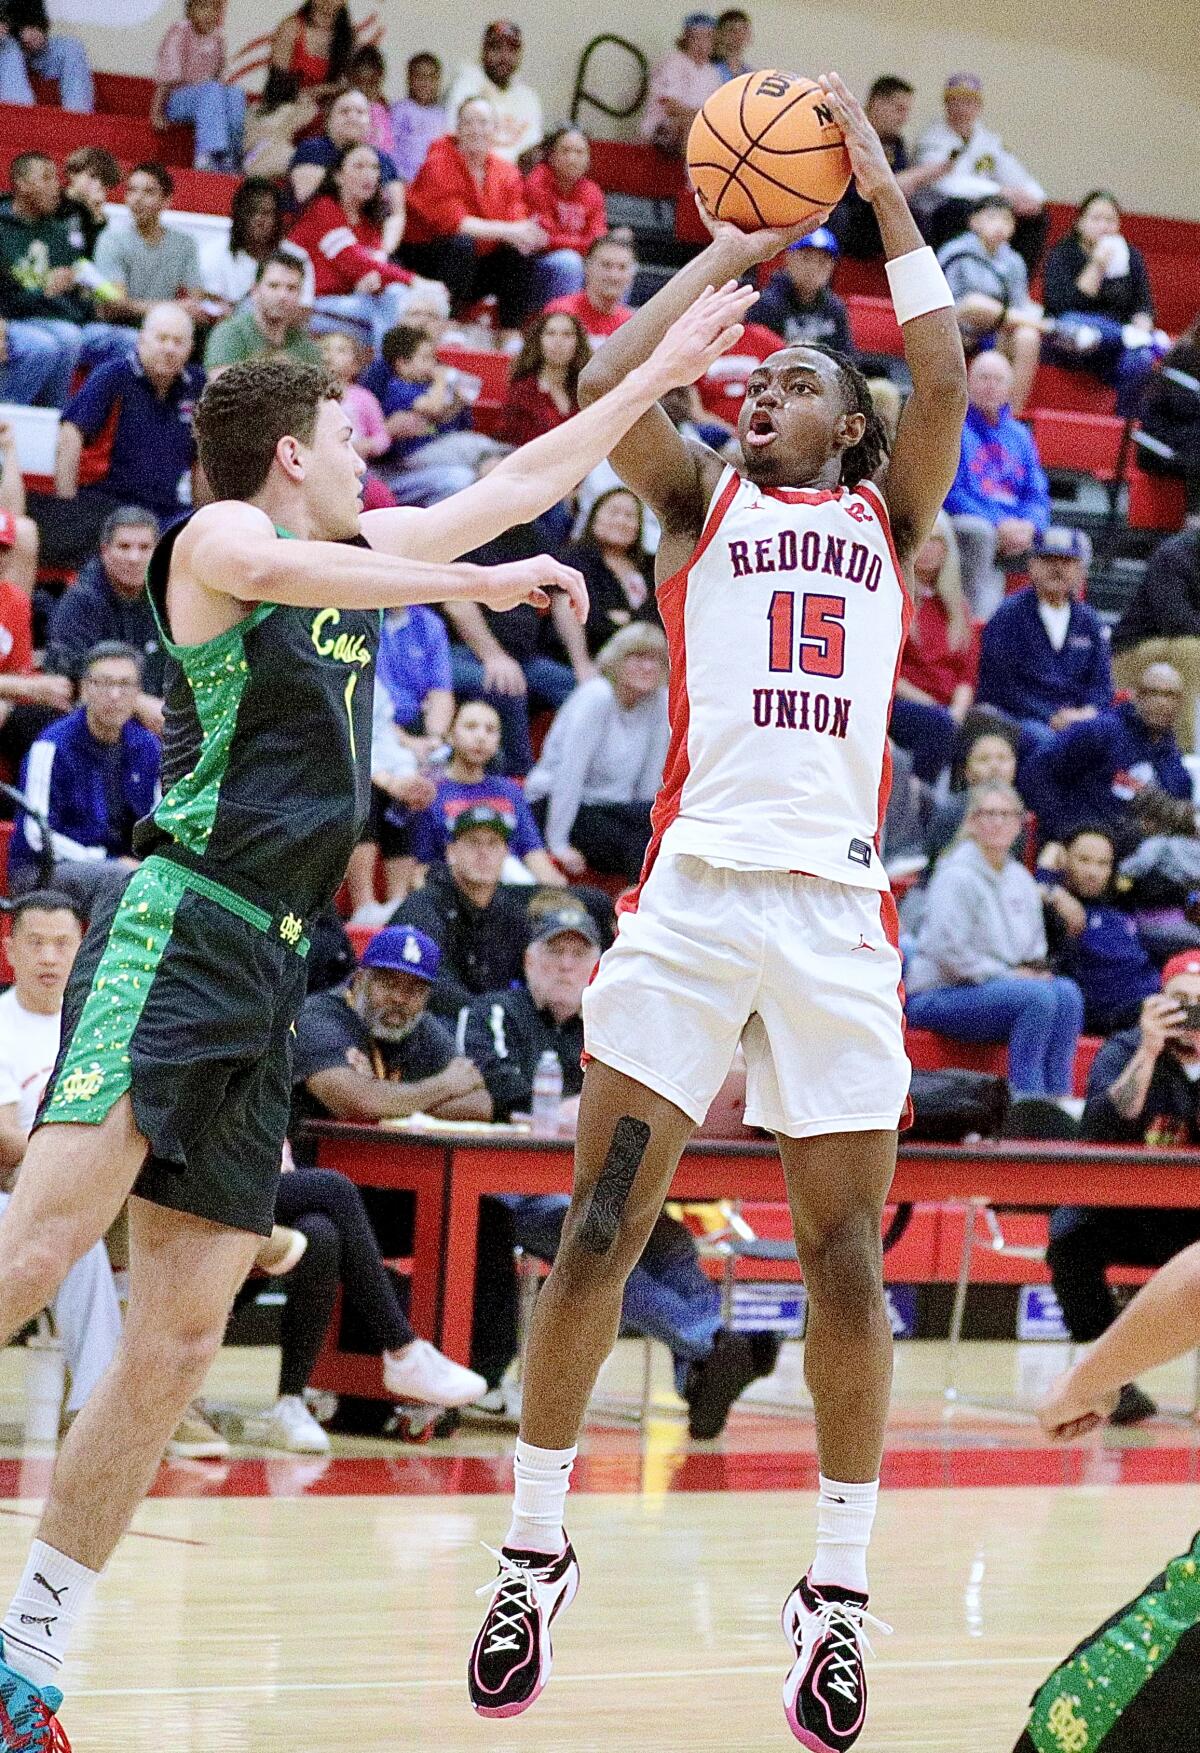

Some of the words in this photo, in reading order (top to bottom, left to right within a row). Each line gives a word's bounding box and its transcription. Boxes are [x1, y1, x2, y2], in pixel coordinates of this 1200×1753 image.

[728, 530, 882, 592] REDONDO
[767, 590, 846, 680] 15
[753, 688, 852, 739] UNION
